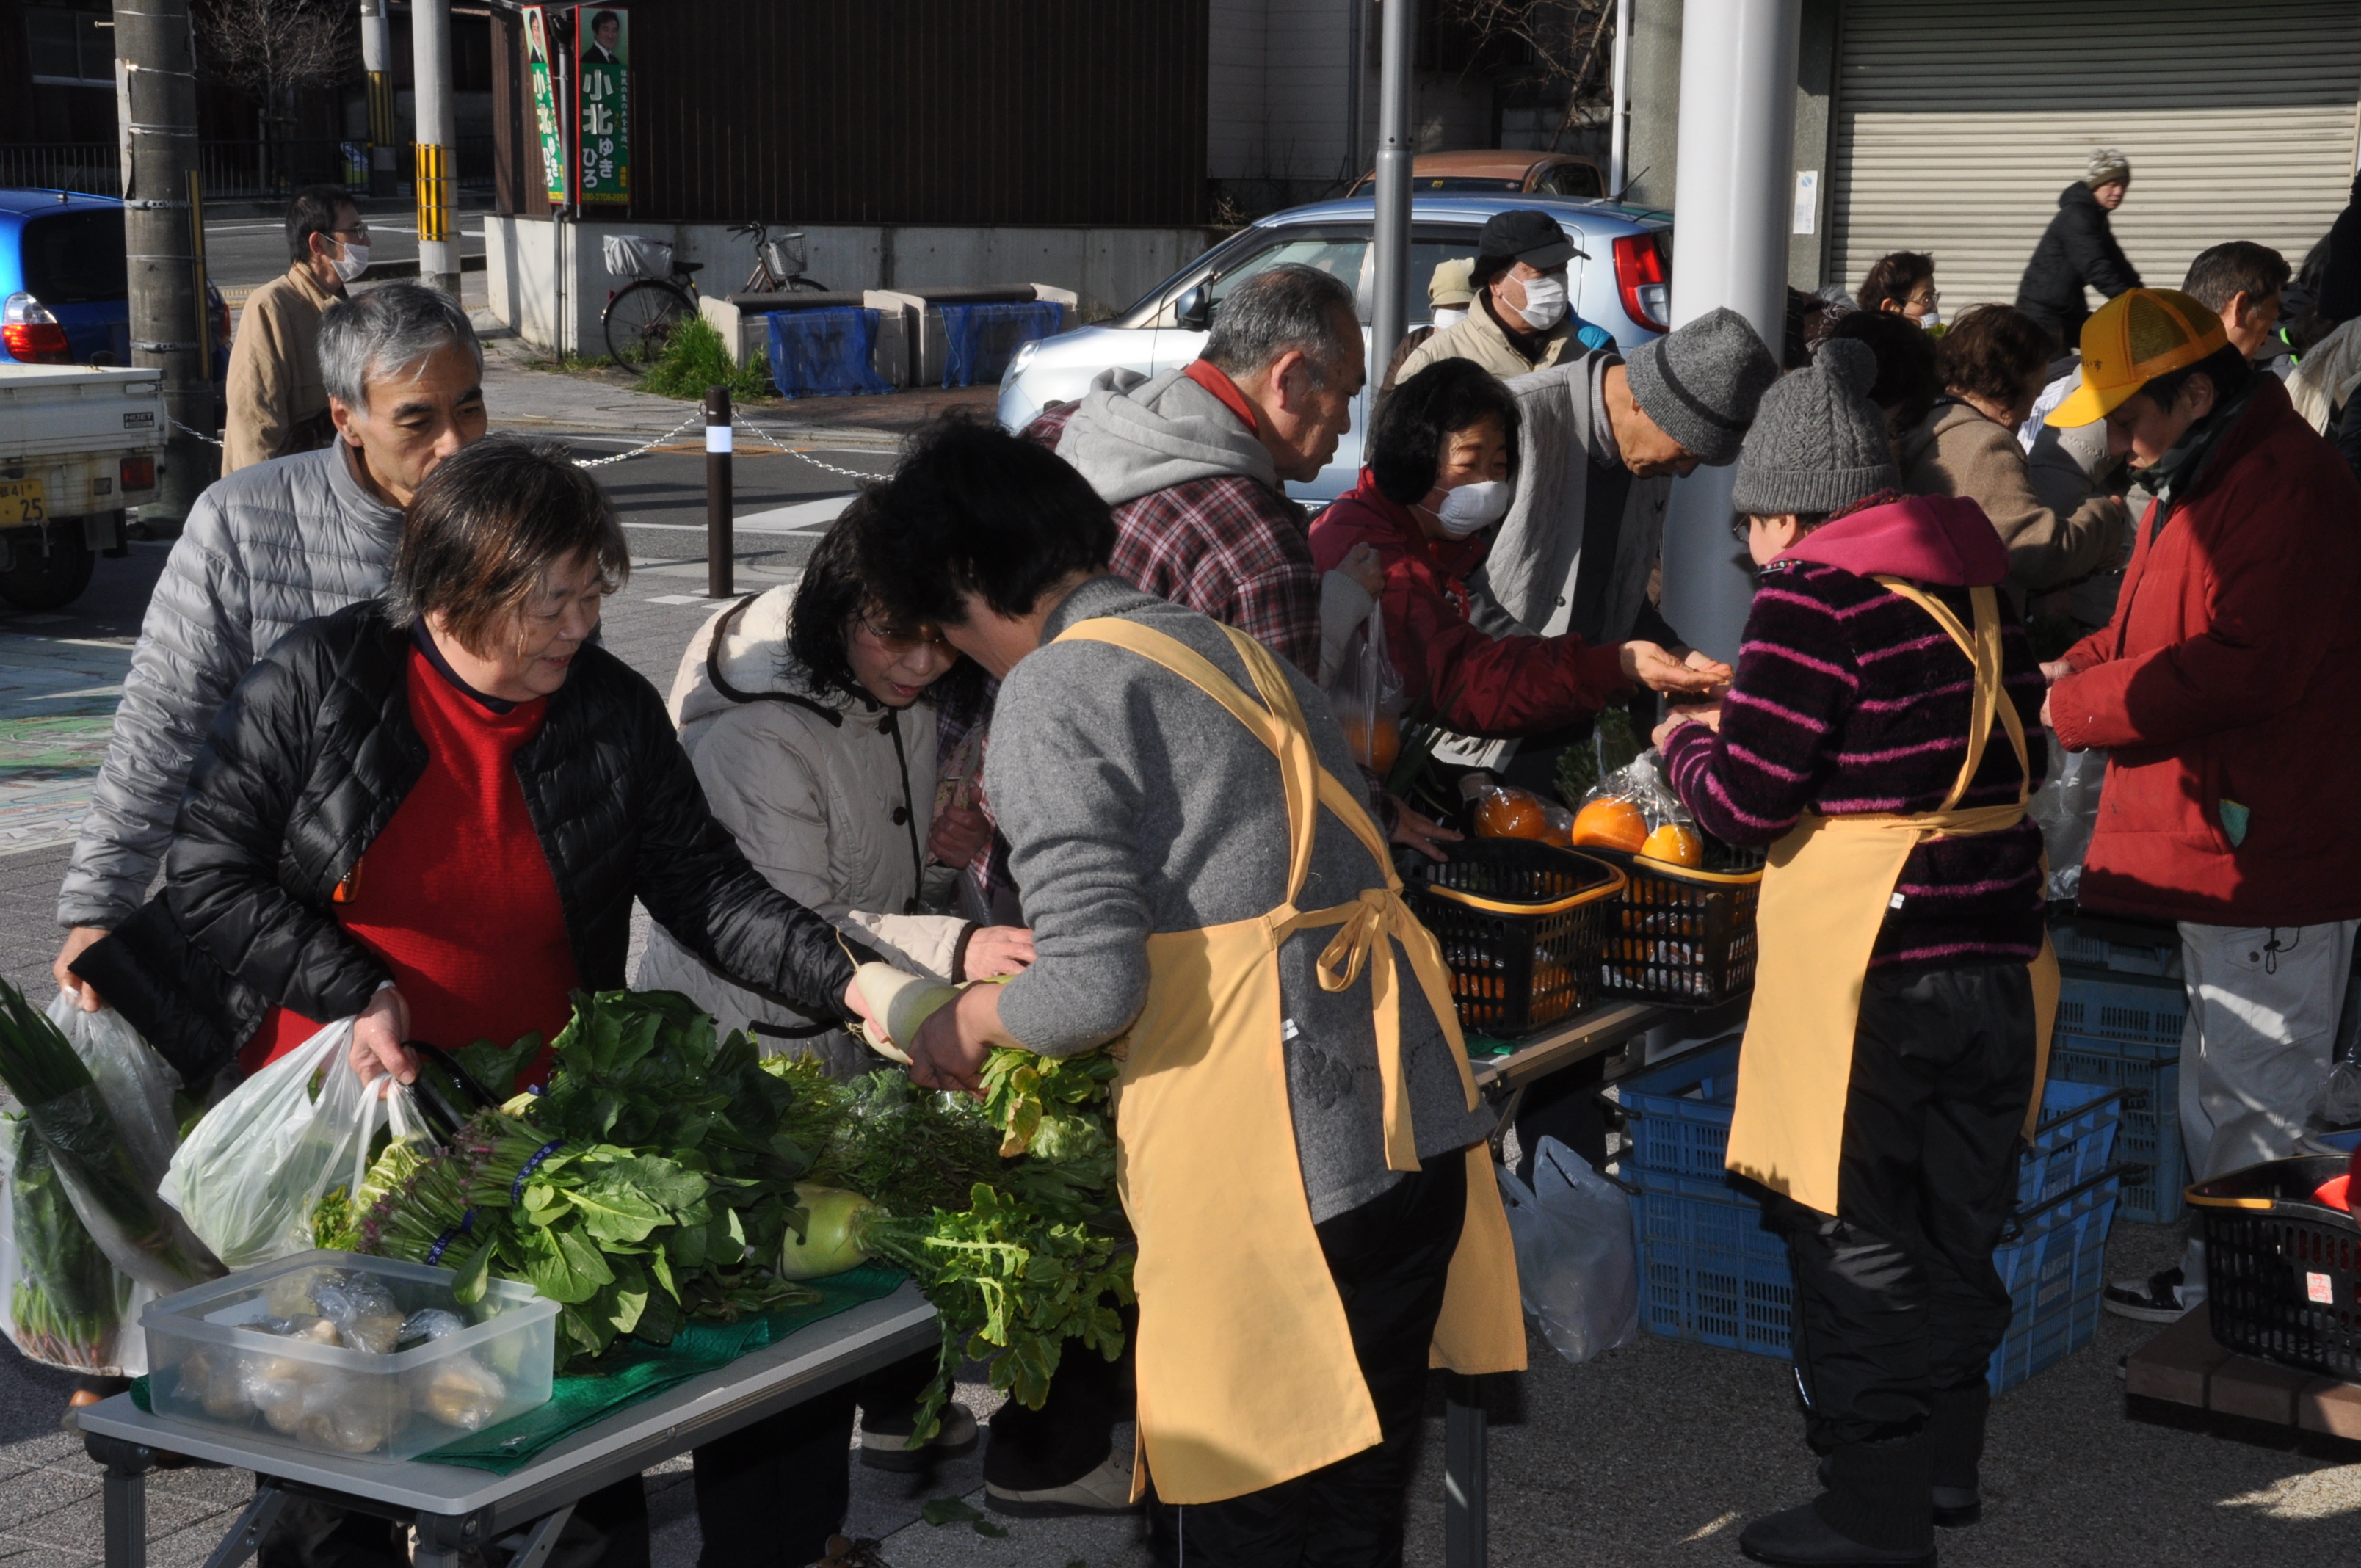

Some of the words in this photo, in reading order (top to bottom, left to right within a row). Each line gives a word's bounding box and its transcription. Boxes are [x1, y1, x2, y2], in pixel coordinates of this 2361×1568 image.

[533, 68, 553, 134] 小北
[582, 69, 614, 135] 小北
[583, 148, 598, 188] ひろ
[598, 137, 614, 178] ゆき
[11, 484, 24, 496] 41
[20, 498, 43, 522] 25
